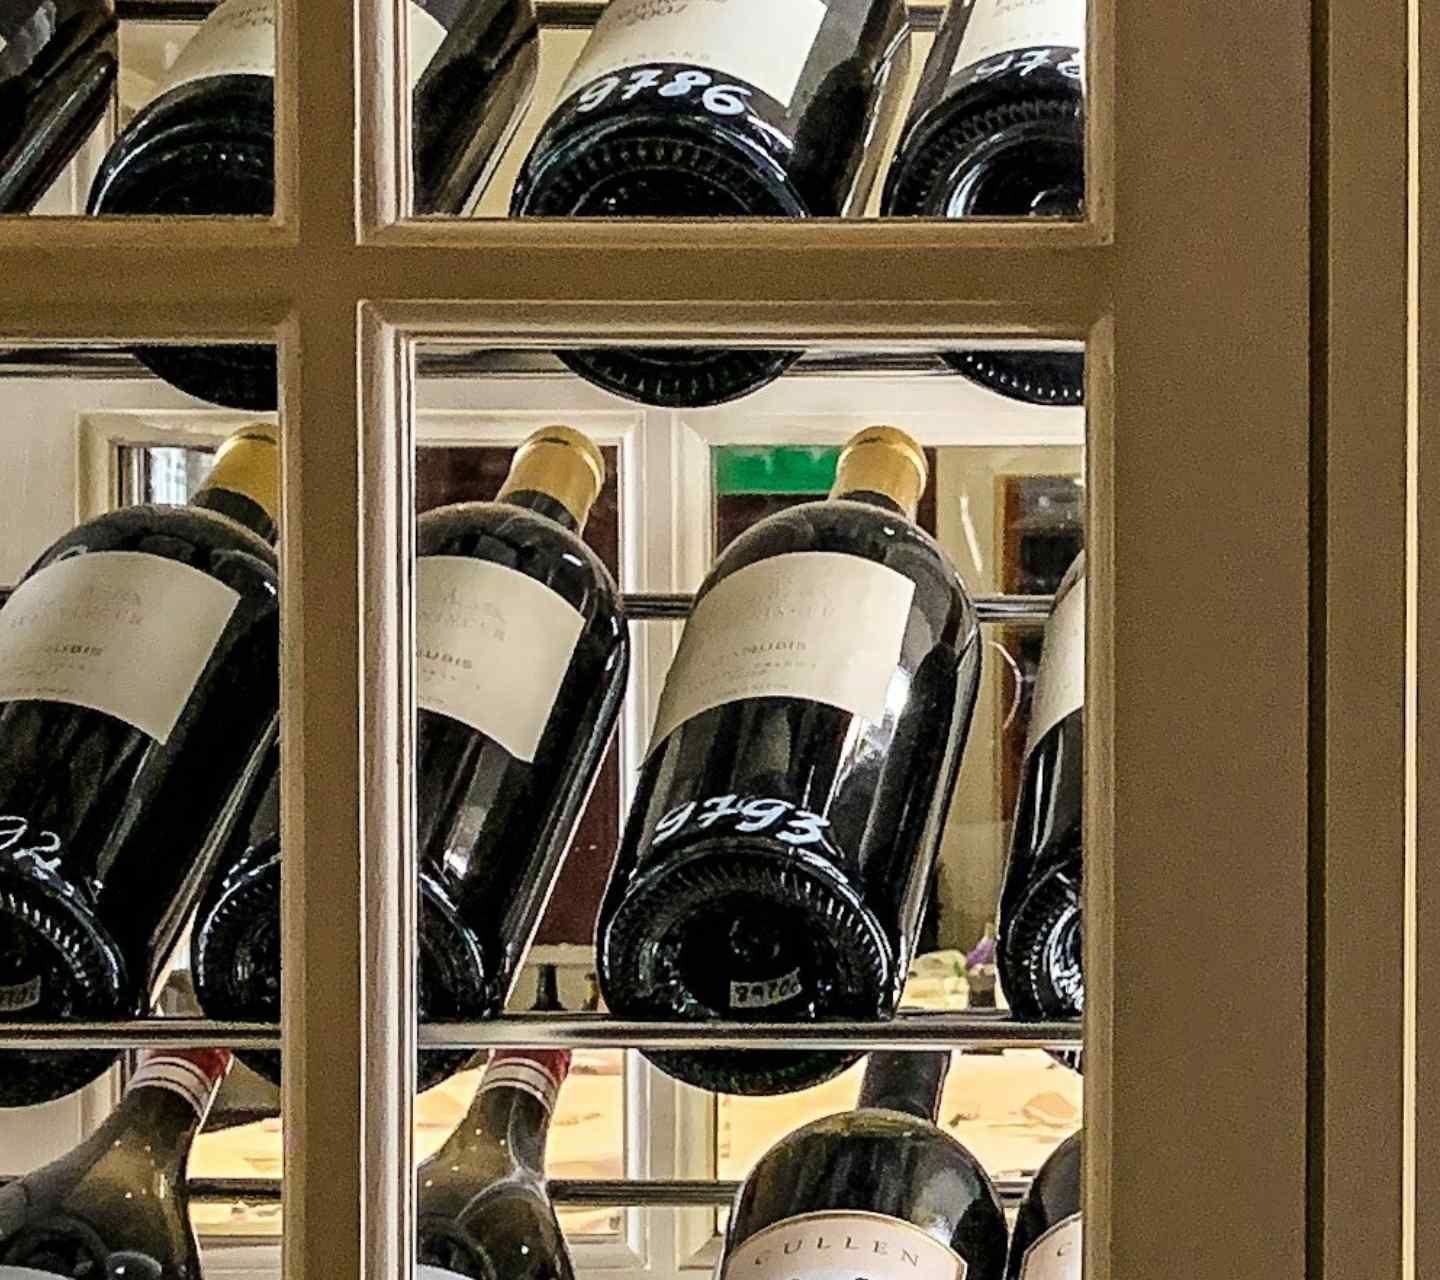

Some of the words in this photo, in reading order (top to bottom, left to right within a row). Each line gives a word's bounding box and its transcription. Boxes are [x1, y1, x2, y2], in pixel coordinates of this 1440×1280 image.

[576, 69, 752, 115] 9786
[652, 794, 831, 845] 9793
[754, 1235, 920, 1268] CULLEN
